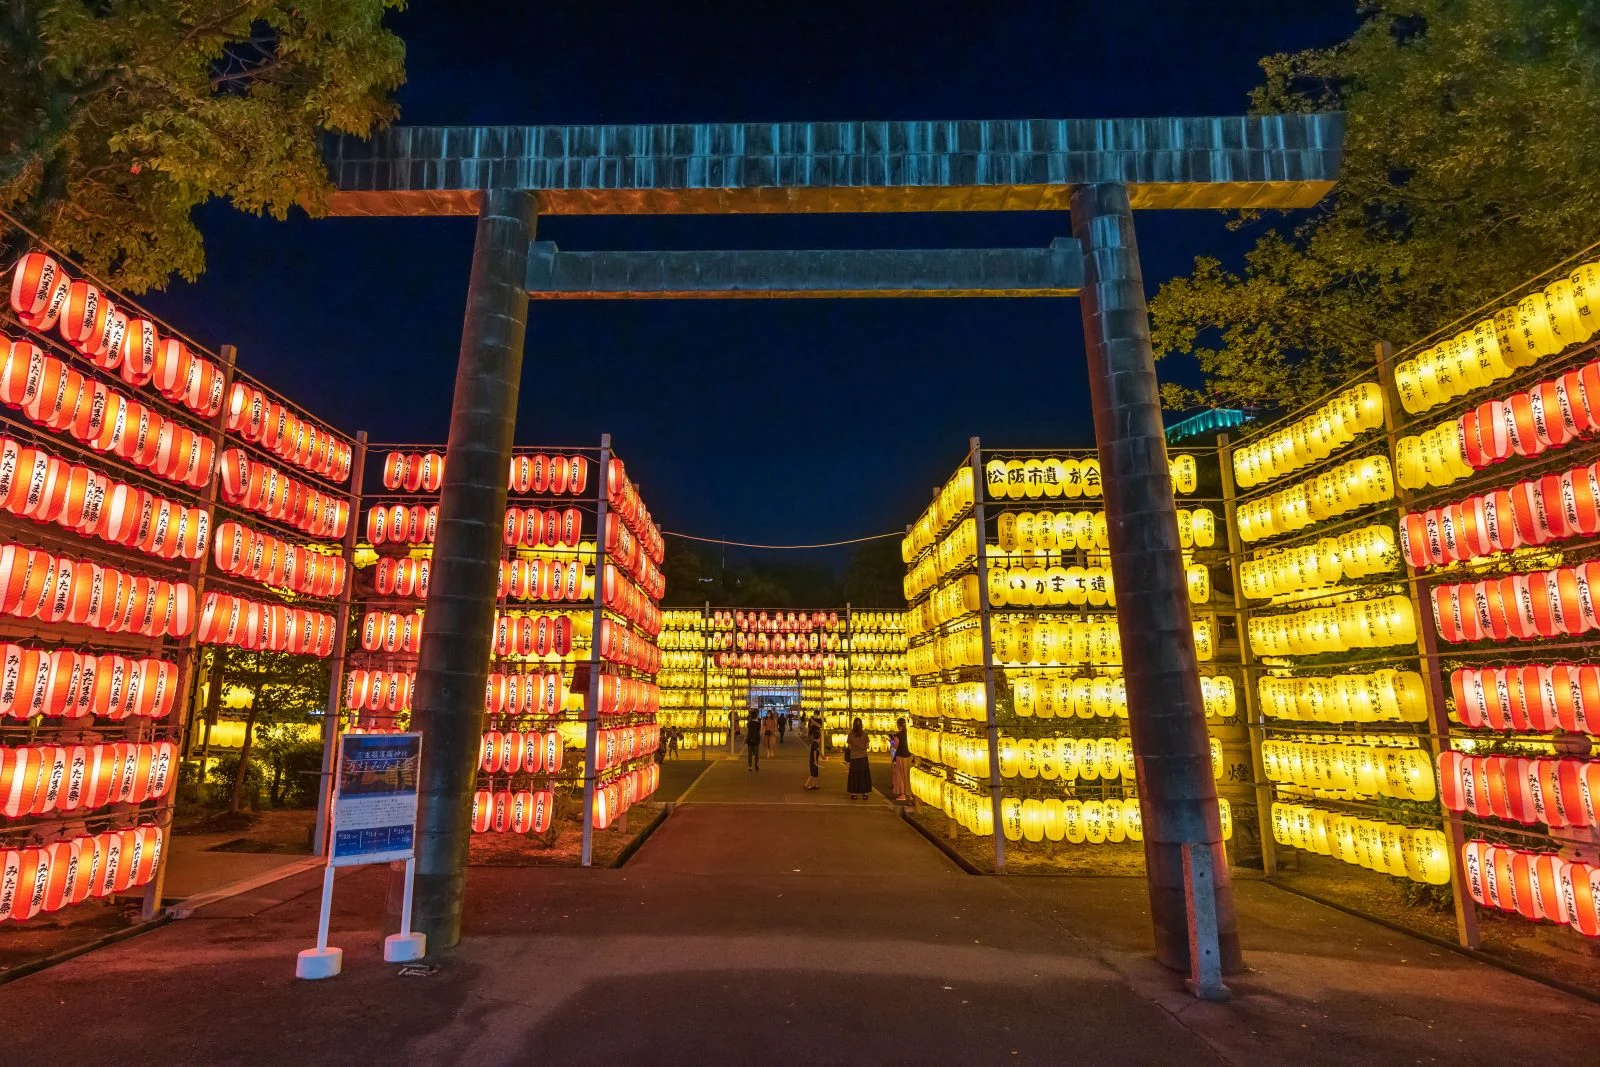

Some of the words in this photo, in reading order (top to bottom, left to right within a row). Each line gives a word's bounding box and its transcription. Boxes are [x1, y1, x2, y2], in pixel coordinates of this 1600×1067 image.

[38, 265, 54, 300] みたま祭
[47, 284, 67, 318] みたま祭
[84, 293, 98, 328] みたま祭
[101, 309, 114, 347] みたま祭
[108, 321, 124, 360] みたま祭
[144, 327, 152, 364] みたま祭
[27, 354, 41, 397] みたま祭
[56, 369, 68, 412] みたま祭
[211, 378, 223, 410] みたま祭
[90, 392, 104, 428] みたま祭
[113, 405, 125, 443] みたま祭
[253, 398, 262, 425] みたま祭
[278, 413, 286, 439] みたま祭
[1532, 394, 1546, 436] みたま祭
[1557, 385, 1574, 428] みたま祭
[138, 414, 147, 450] みたま祭
[1504, 407, 1519, 447] みたま祭
[0, 450, 15, 496] みたま祭
[28, 461, 46, 504] みたま祭
[83, 479, 95, 519] みたま祭
[90, 487, 104, 522] みたま祭
[1535, 490, 1548, 530] みたま祭
[1563, 480, 1576, 523] みたま祭
[139, 500, 152, 539] みたま祭
[155, 509, 169, 545] みたま祭
[177, 515, 187, 550] みたま祭
[198, 517, 208, 551] みたま祭
[1427, 519, 1440, 556] みたま祭
[1443, 516, 1455, 549] みたま祭
[1486, 501, 1498, 541] みたま祭
[233, 531, 241, 562] みたま祭
[254, 540, 263, 570] みたま祭
[1401, 526, 1410, 556] みたま祭
[38, 565, 54, 609] みたま祭
[54, 569, 70, 613] みたま祭
[90, 574, 101, 615] みたま祭
[144, 587, 155, 625] みたま祭
[1522, 587, 1534, 624] みたま祭
[1548, 580, 1562, 623] みたま祭
[1577, 577, 1592, 617] みたま祭
[228, 605, 237, 636] みたま祭
[1477, 593, 1490, 628] みたま祭
[3, 656, 18, 703] みたま祭
[33, 663, 48, 708] みたま祭
[67, 664, 80, 706] みたま祭
[79, 668, 94, 706] みたま祭
[111, 666, 123, 706] みたま祭
[126, 671, 139, 711] みたま祭
[372, 678, 380, 704] みたま祭
[1475, 680, 1488, 721] みたま祭
[1498, 681, 1511, 722] みたま祭
[1571, 681, 1584, 722] みたま祭
[47, 762, 64, 800] みたま祭
[68, 758, 84, 801] みたま祭
[122, 755, 134, 795] みたま祭
[155, 753, 169, 791] みたま祭
[1463, 768, 1474, 808] みたま祭
[1530, 774, 1543, 816] みたま祭
[1552, 772, 1564, 817] みたま祭
[64, 857, 78, 897] みたま祭
[88, 851, 99, 889] みたま祭
[105, 847, 119, 889] みたま祭
[130, 843, 141, 879] みたま祭
[1468, 855, 1482, 896] みたま祭
[1486, 859, 1497, 900] みたま祭
[0, 866, 18, 914] みたま祭
[32, 863, 48, 905] みたま祭
[1563, 876, 1577, 924] みたま祭
